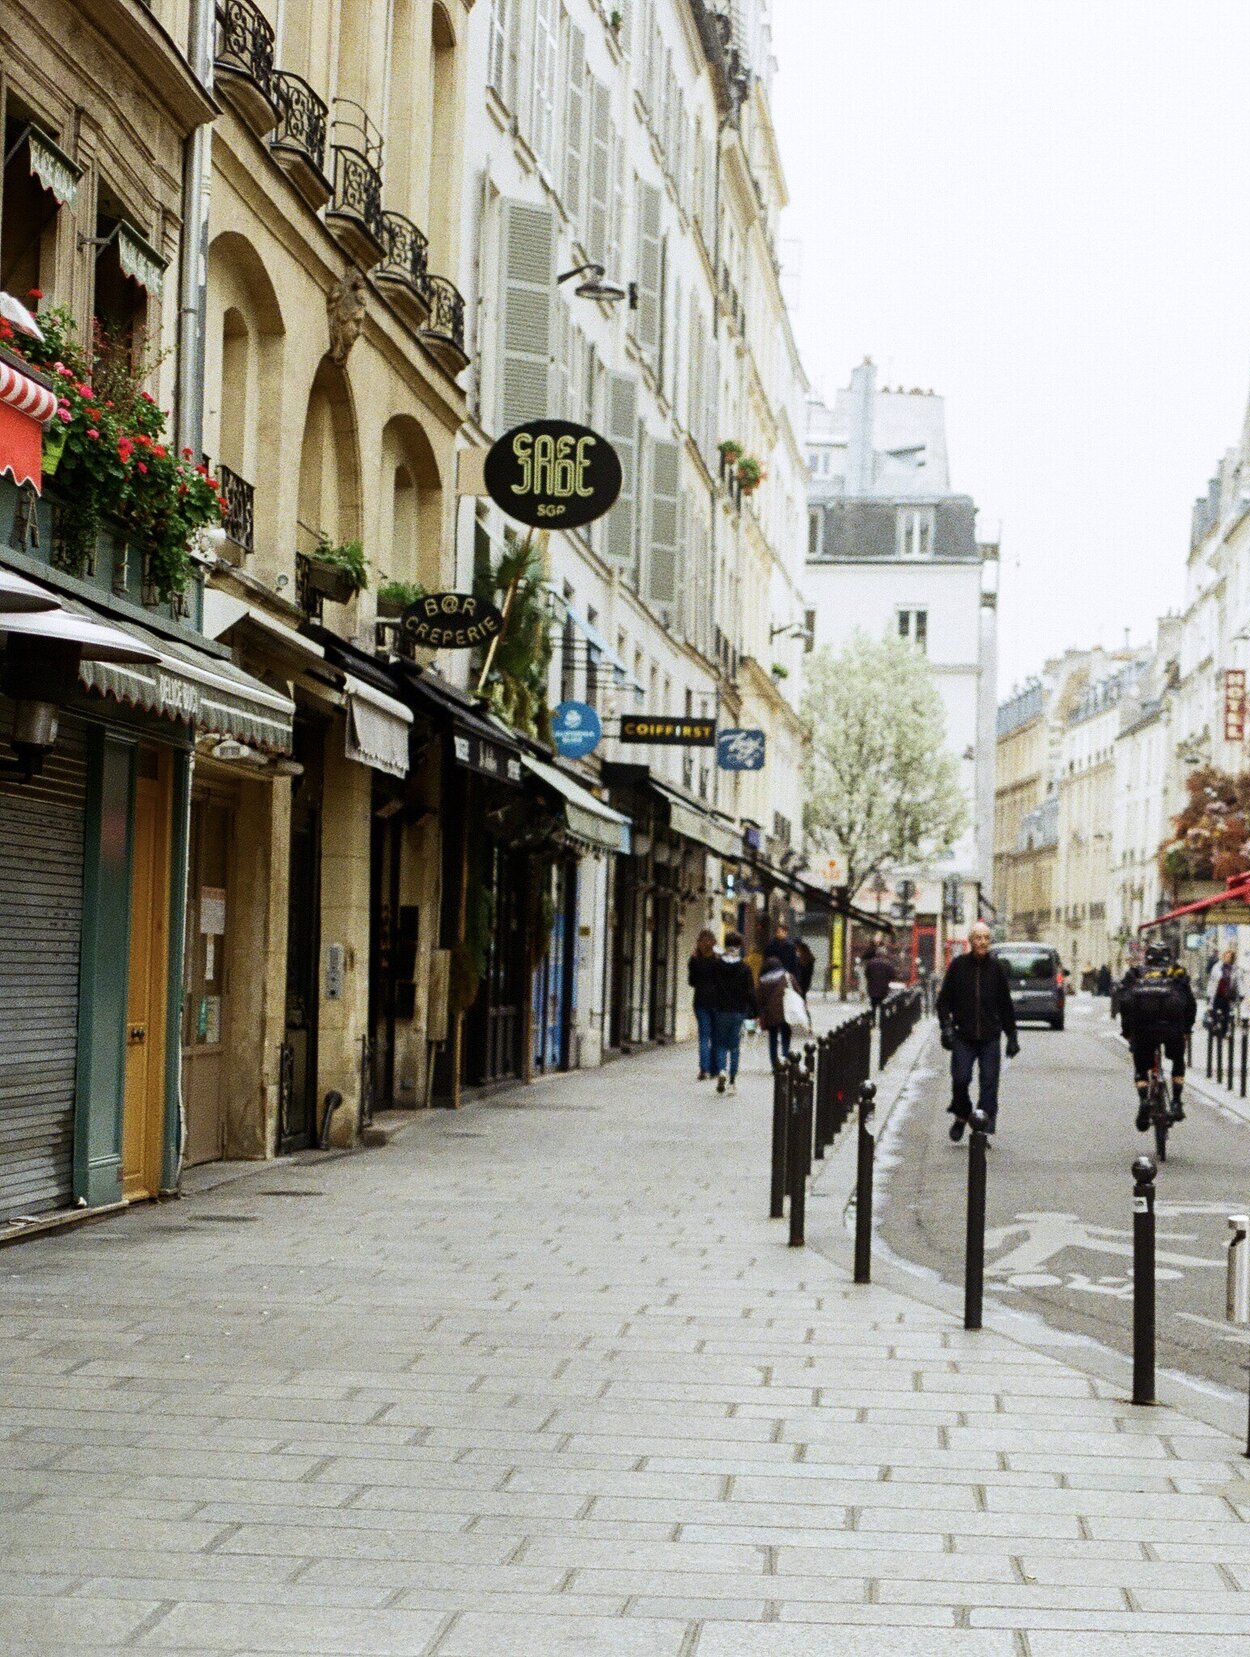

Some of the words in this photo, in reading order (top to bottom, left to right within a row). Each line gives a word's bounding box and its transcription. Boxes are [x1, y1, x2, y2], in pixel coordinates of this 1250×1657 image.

[537, 504, 566, 518] SGP
[405, 616, 498, 646] CREPERIE
[624, 722, 712, 739] COIFFIRST
